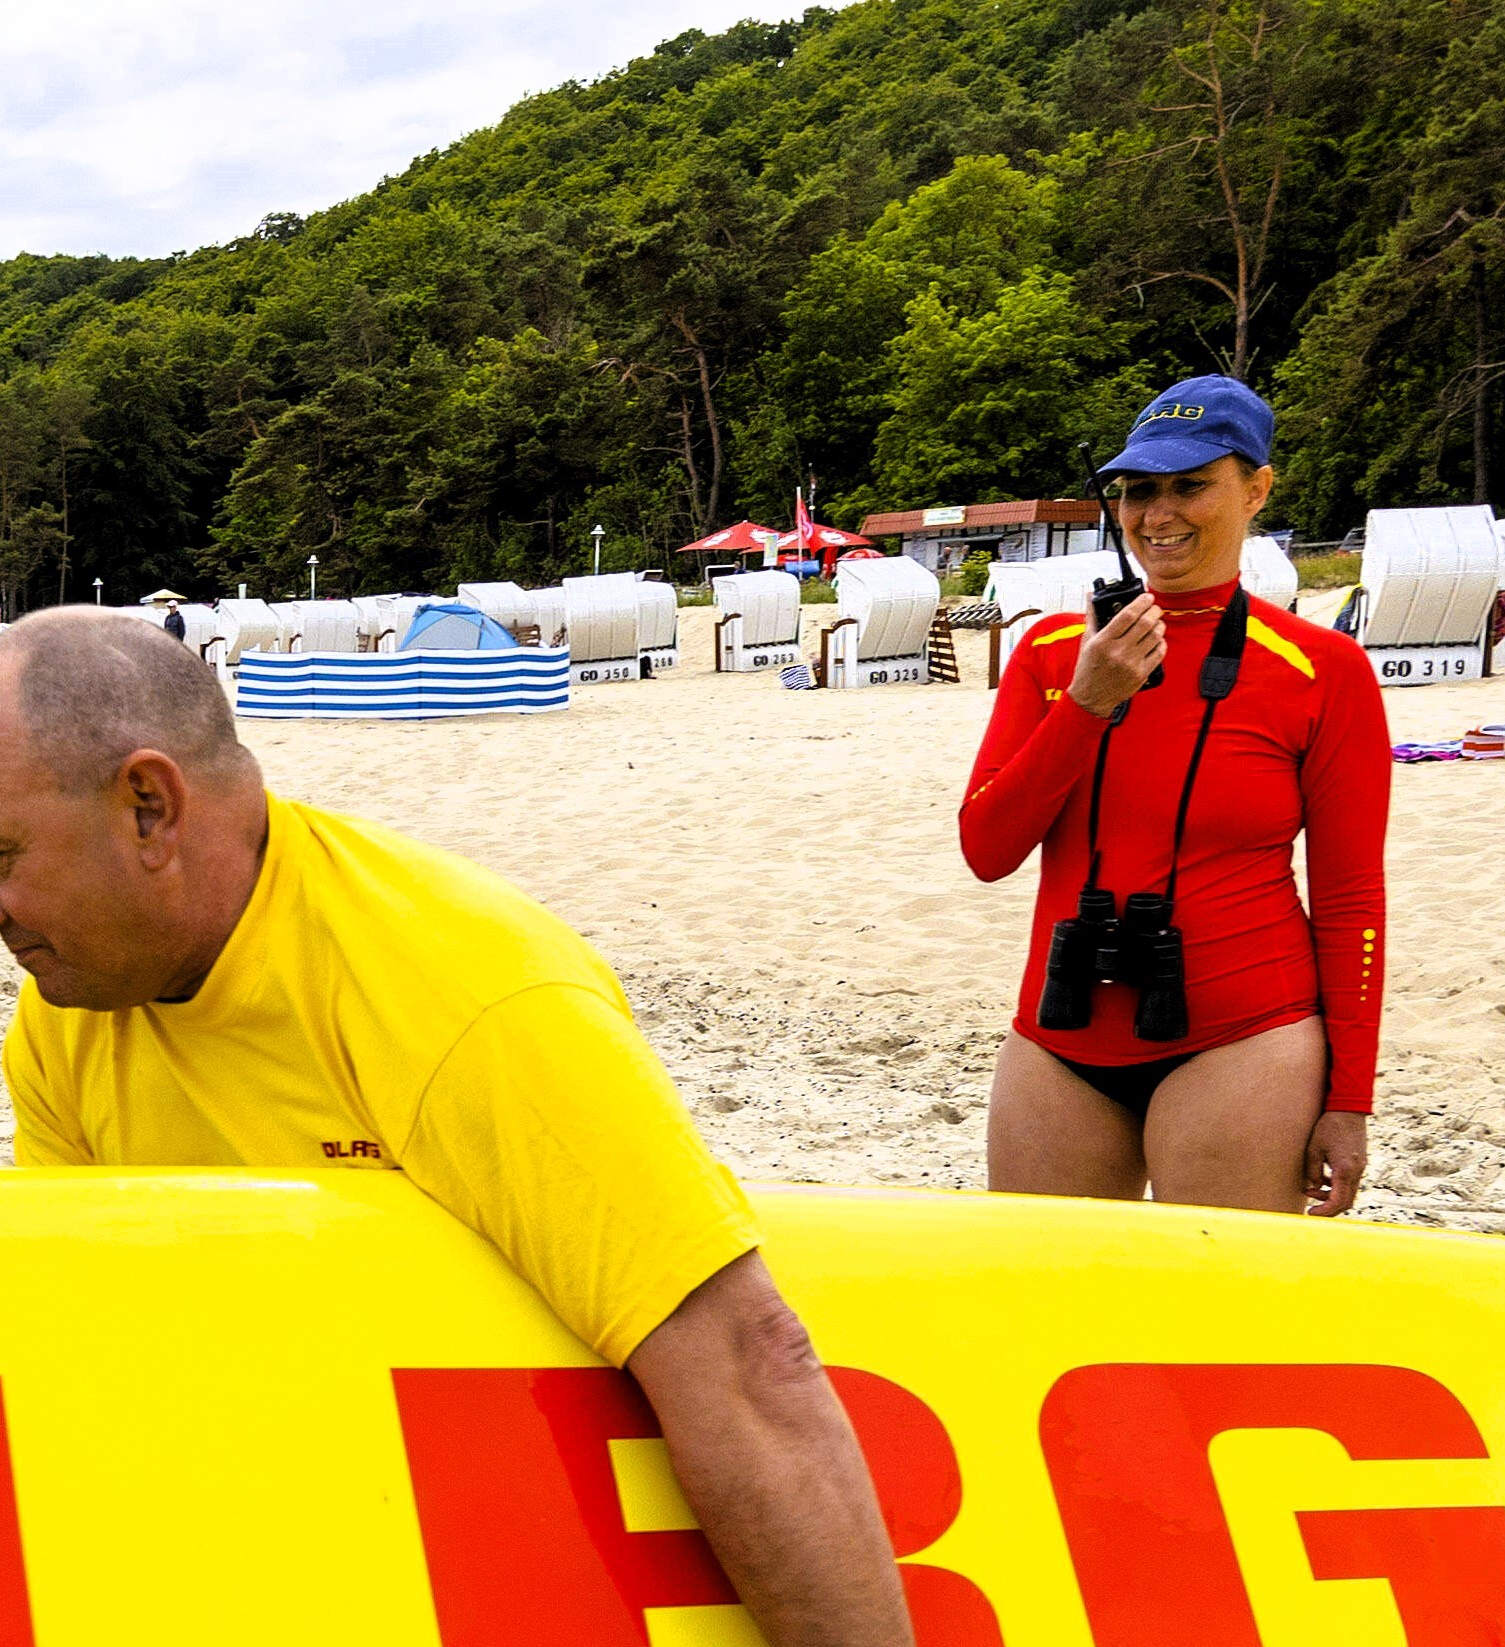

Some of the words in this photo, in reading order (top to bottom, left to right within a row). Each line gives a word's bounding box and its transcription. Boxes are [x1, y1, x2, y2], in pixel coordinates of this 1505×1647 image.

[752, 654, 769, 667] GO
[1381, 659, 1412, 677] GO
[1423, 658, 1466, 676] 319
[579, 666, 599, 682] GO
[869, 669, 889, 685] GO
